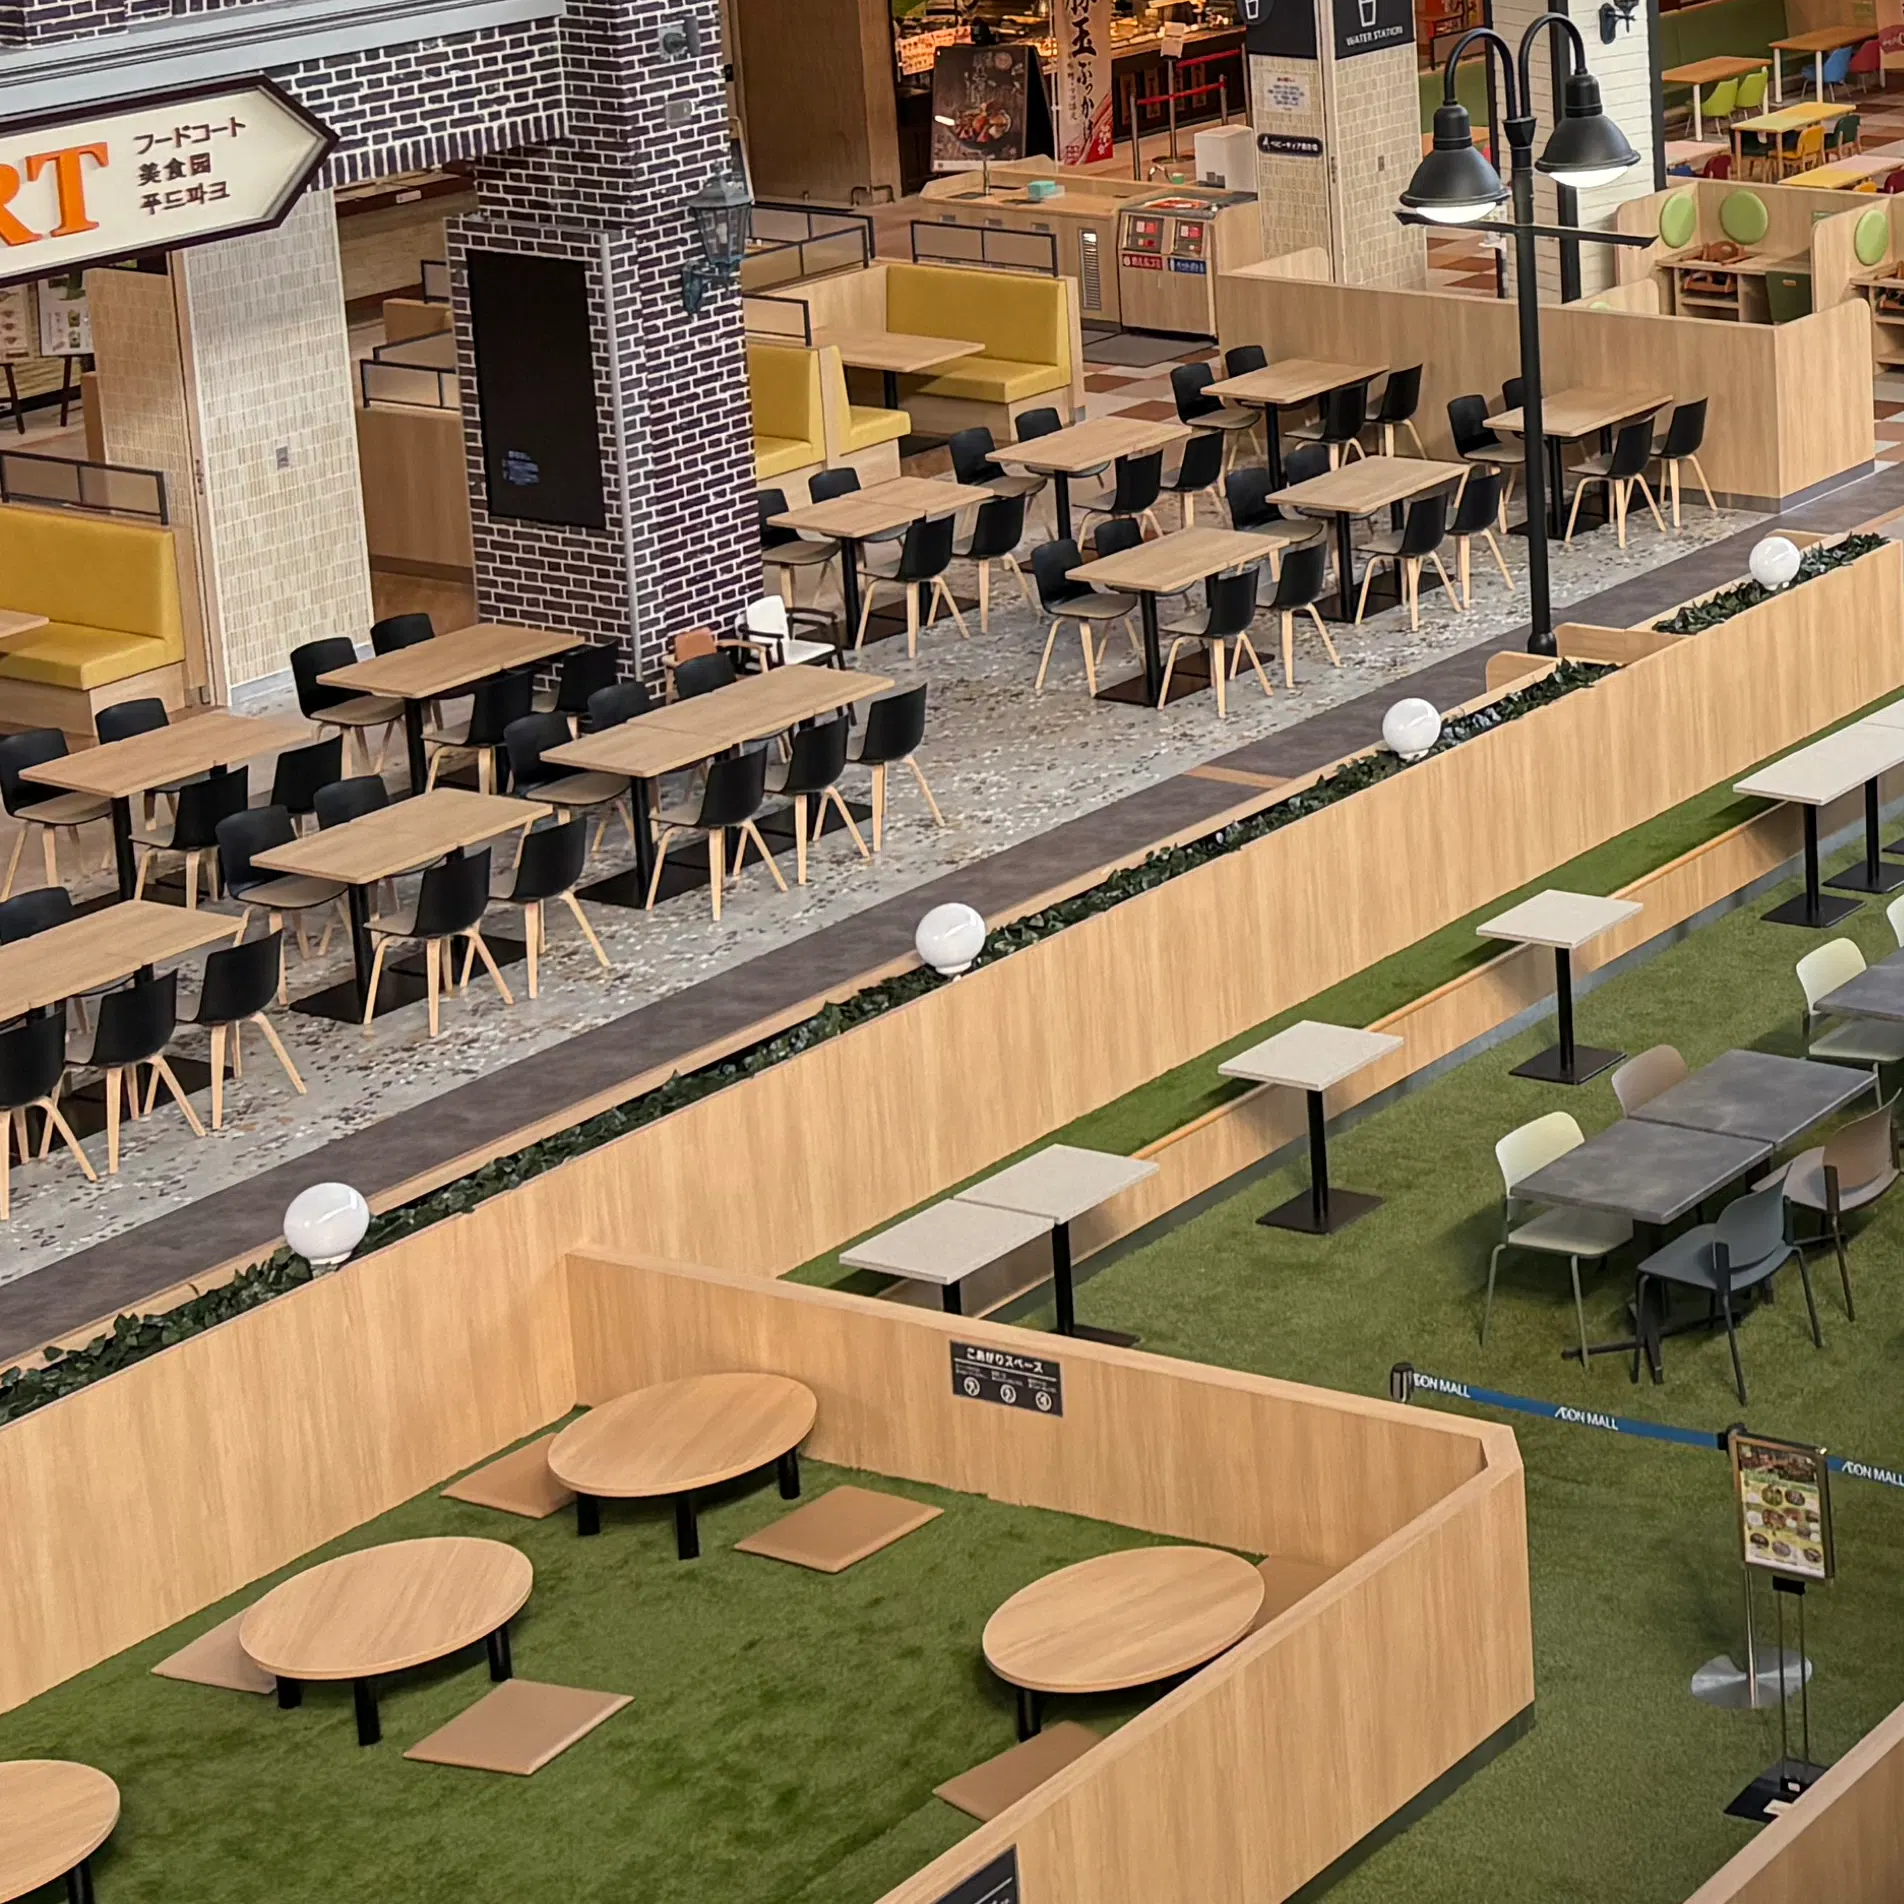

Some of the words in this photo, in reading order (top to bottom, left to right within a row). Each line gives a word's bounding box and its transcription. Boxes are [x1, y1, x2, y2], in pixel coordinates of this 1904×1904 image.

[1346, 29, 1373, 46] WATER
[133, 116, 247, 155] フードコート
[139, 180, 231, 215] 푸드파크
[1439, 1380, 1471, 1398] MALL
[1586, 1412, 1619, 1431] MALL
